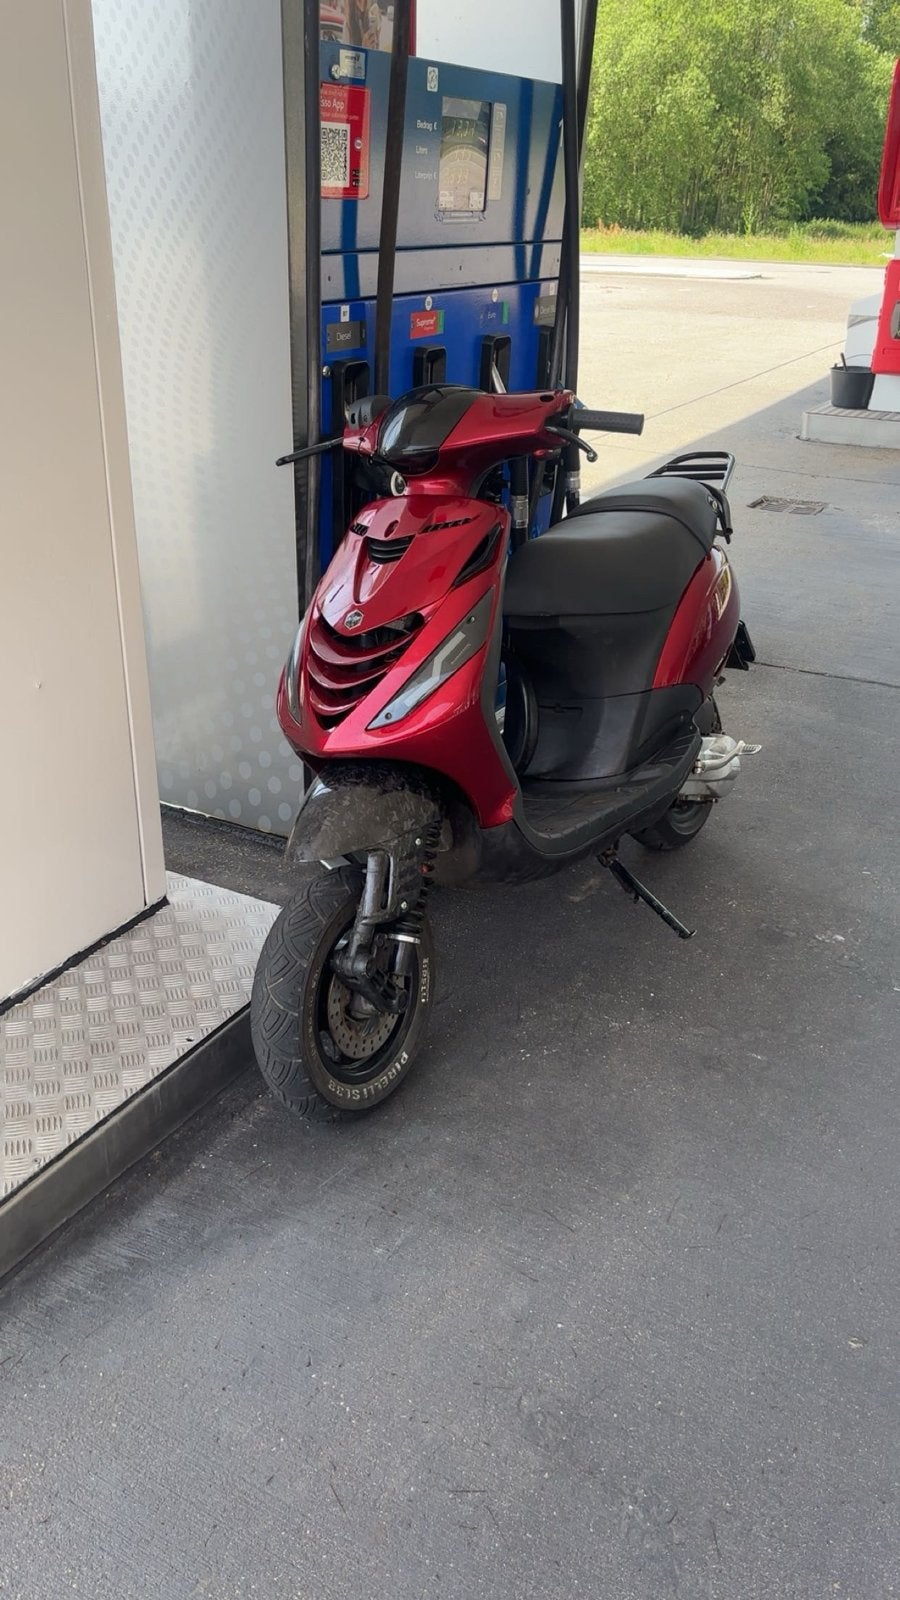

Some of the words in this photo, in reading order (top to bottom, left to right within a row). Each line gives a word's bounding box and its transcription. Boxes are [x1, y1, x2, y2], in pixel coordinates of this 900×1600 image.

[320, 97, 332, 108] sso
[332, 98, 345, 111] App
[416, 120, 433, 132] Bedrag
[336, 331, 351, 341] Diesel
[363, 1051, 409, 1098] PIRELLI
